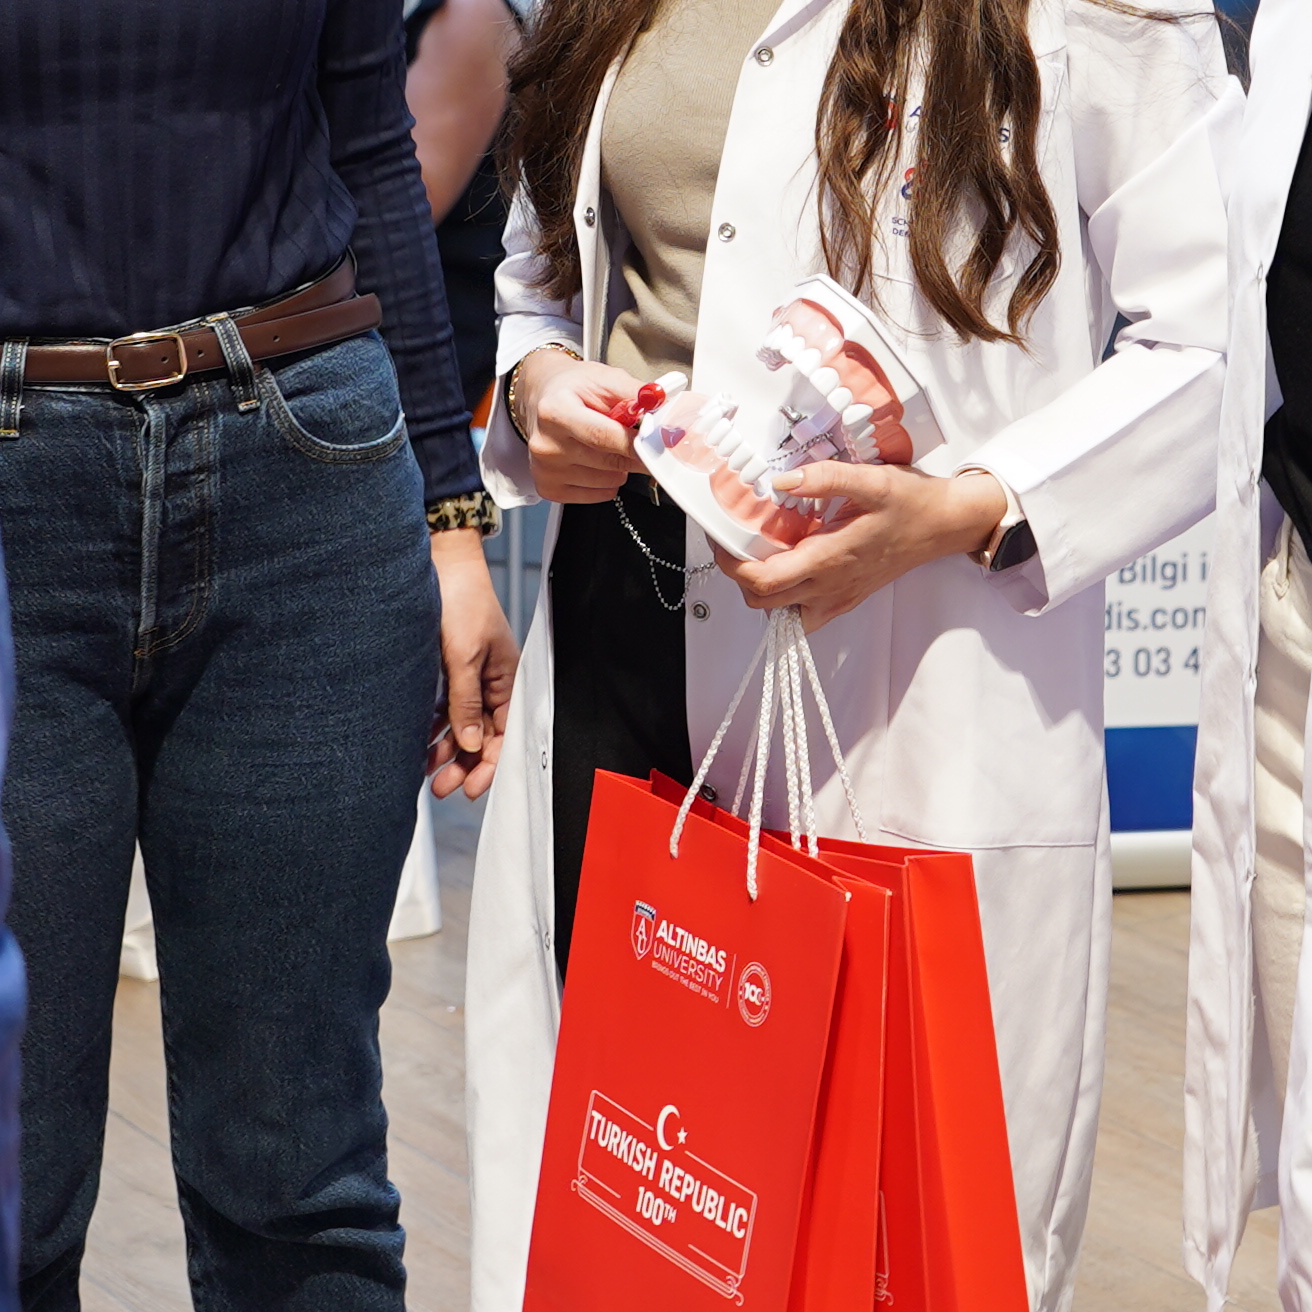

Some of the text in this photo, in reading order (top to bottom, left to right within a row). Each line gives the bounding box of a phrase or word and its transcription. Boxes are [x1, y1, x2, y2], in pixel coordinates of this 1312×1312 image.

[1118, 552, 1189, 589] Bilgi
[1133, 647, 1172, 677] 03
[653, 940, 724, 992] UNIVERSITY
[656, 919, 727, 973] ALTINBAS
[590, 1109, 748, 1239] TURKISH REPUBLIC
